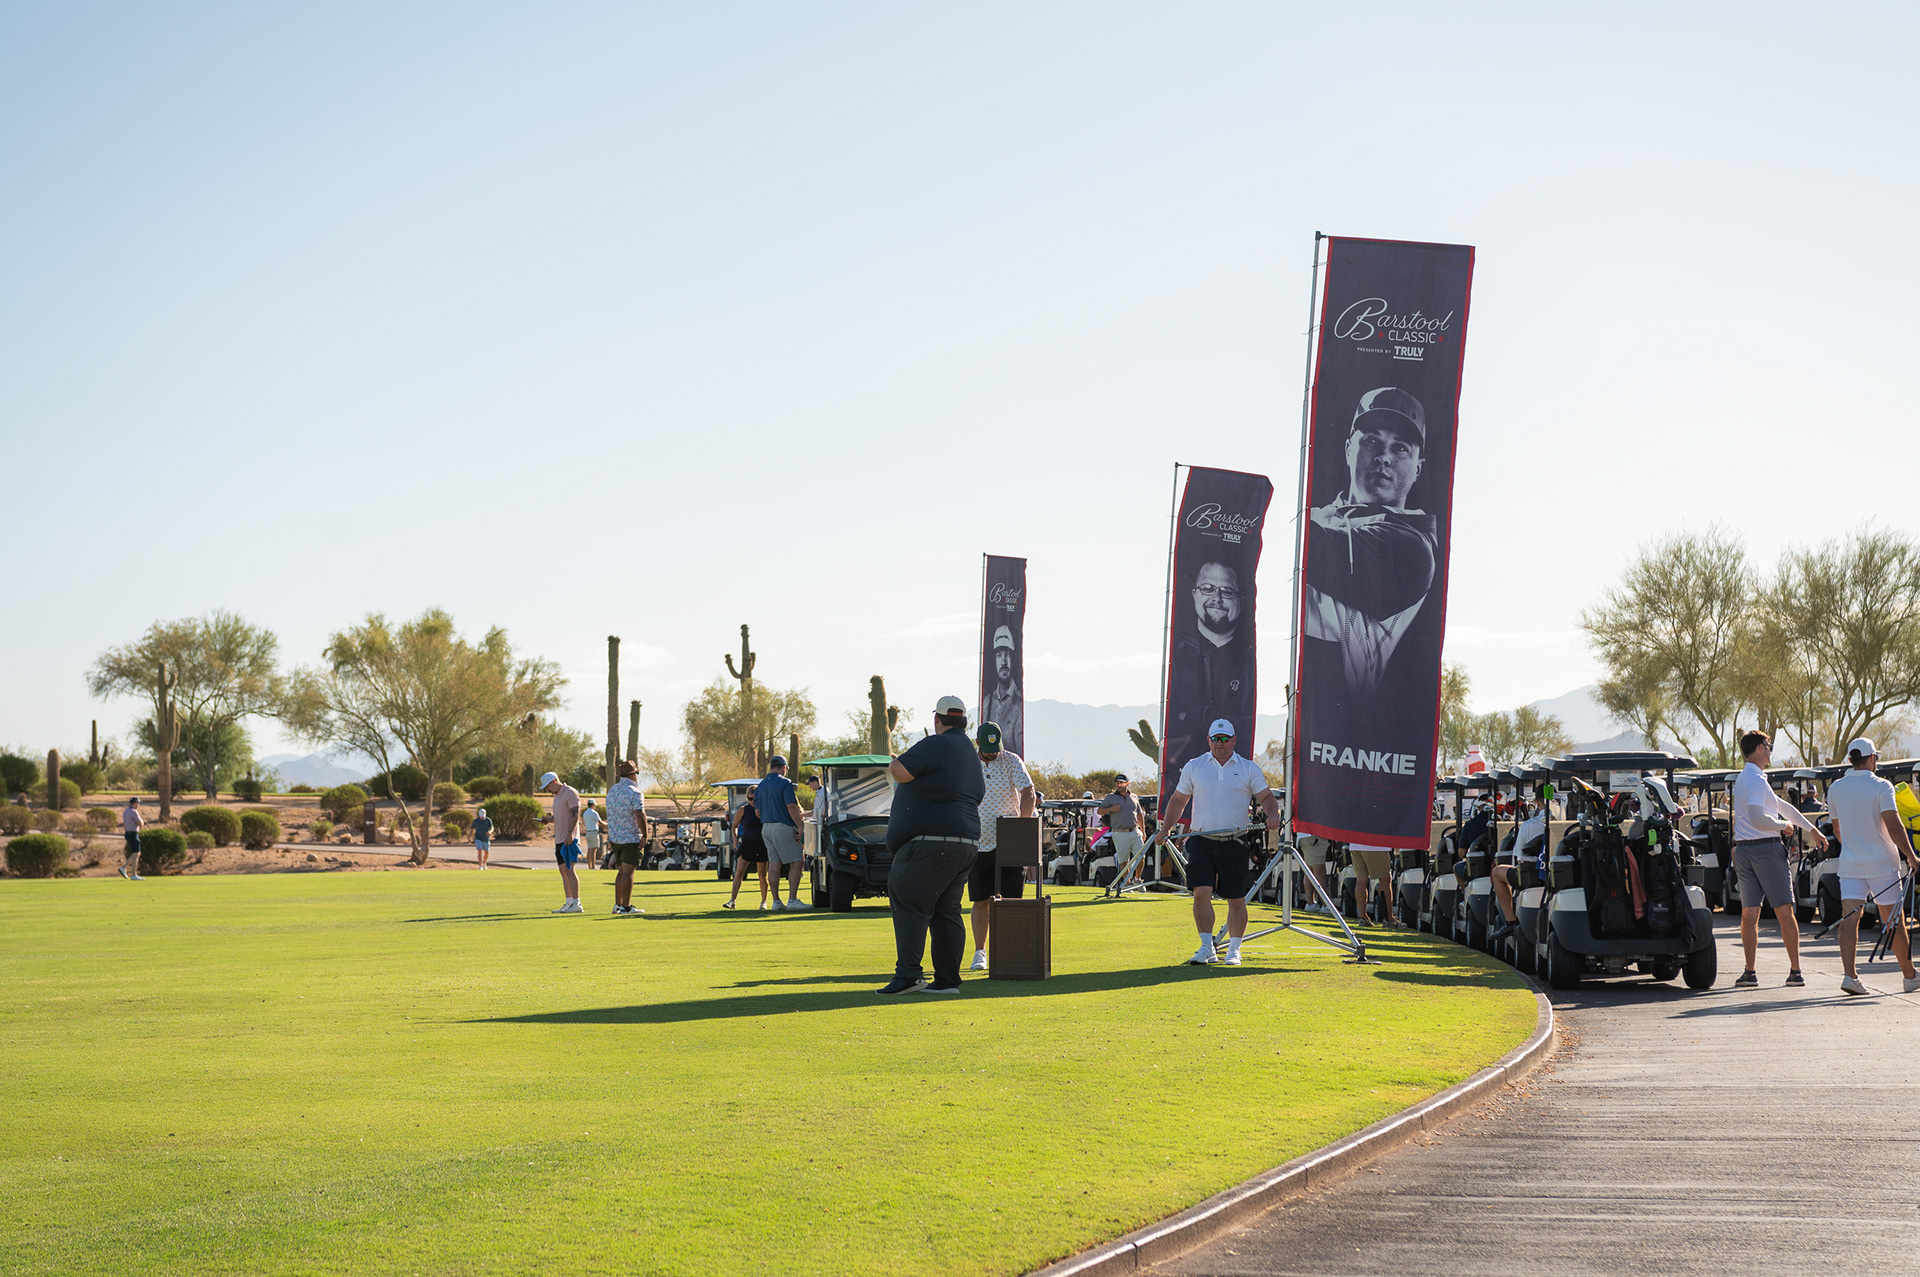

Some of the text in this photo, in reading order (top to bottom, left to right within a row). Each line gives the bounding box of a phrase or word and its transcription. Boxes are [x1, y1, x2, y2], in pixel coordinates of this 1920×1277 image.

[1334, 297, 1454, 341] Barstool
[1388, 329, 1437, 344] CLASSIC
[1356, 346, 1383, 354] PRESENTED
[1394, 345, 1424, 357] TRULY
[1186, 502, 1260, 529] Barstool
[1219, 523, 1248, 534] CLASSIC
[1223, 533, 1242, 541] TRULY
[1310, 741, 1417, 776] FRANKIE
